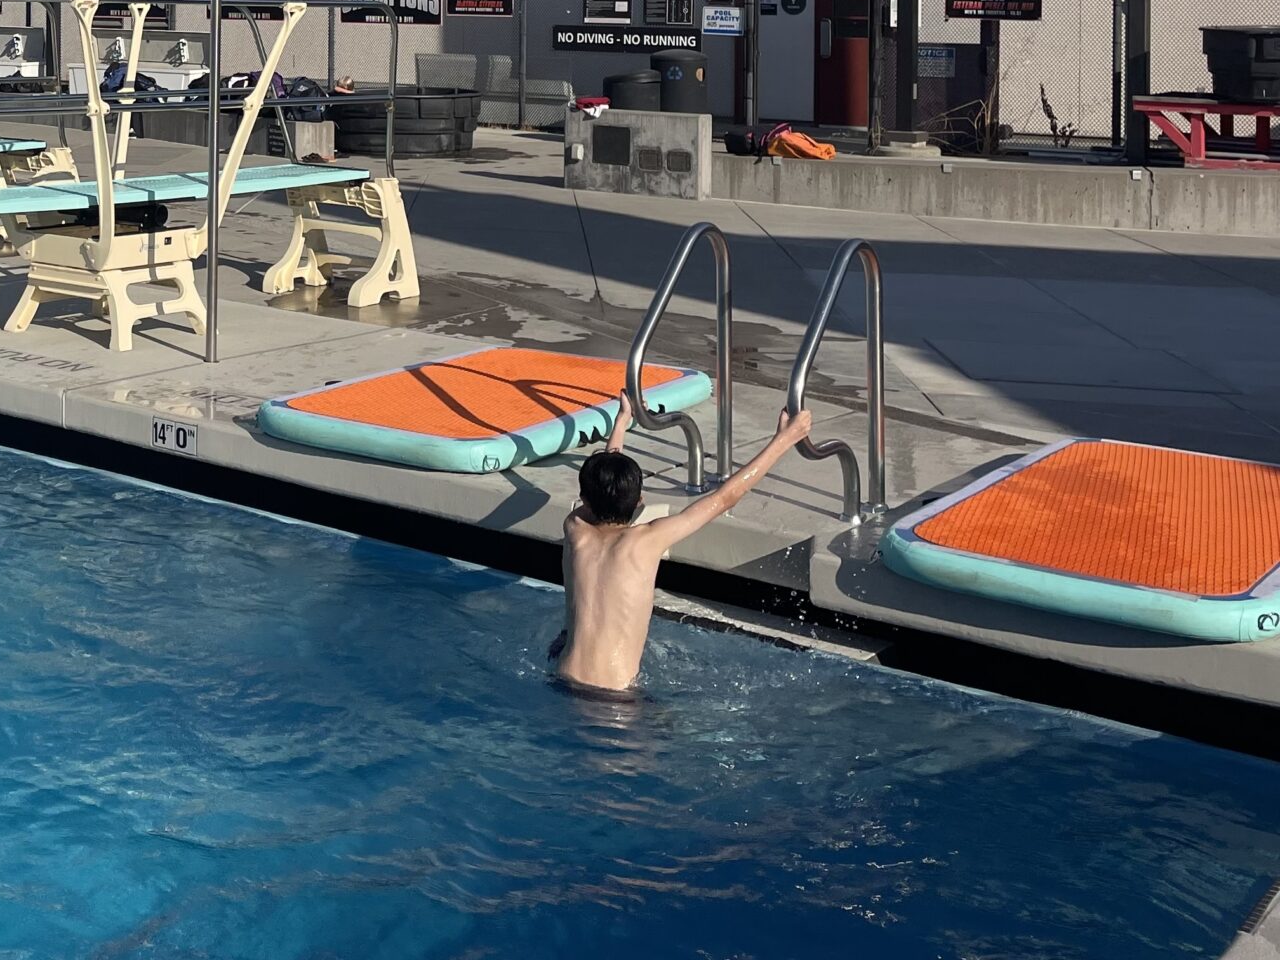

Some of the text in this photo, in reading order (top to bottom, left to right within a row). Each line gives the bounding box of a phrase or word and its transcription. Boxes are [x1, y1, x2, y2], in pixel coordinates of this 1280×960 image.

[557, 32, 574, 43] NO
[576, 33, 614, 44] DIVING
[623, 34, 641, 45] NO
[643, 35, 697, 47] RUNNING
